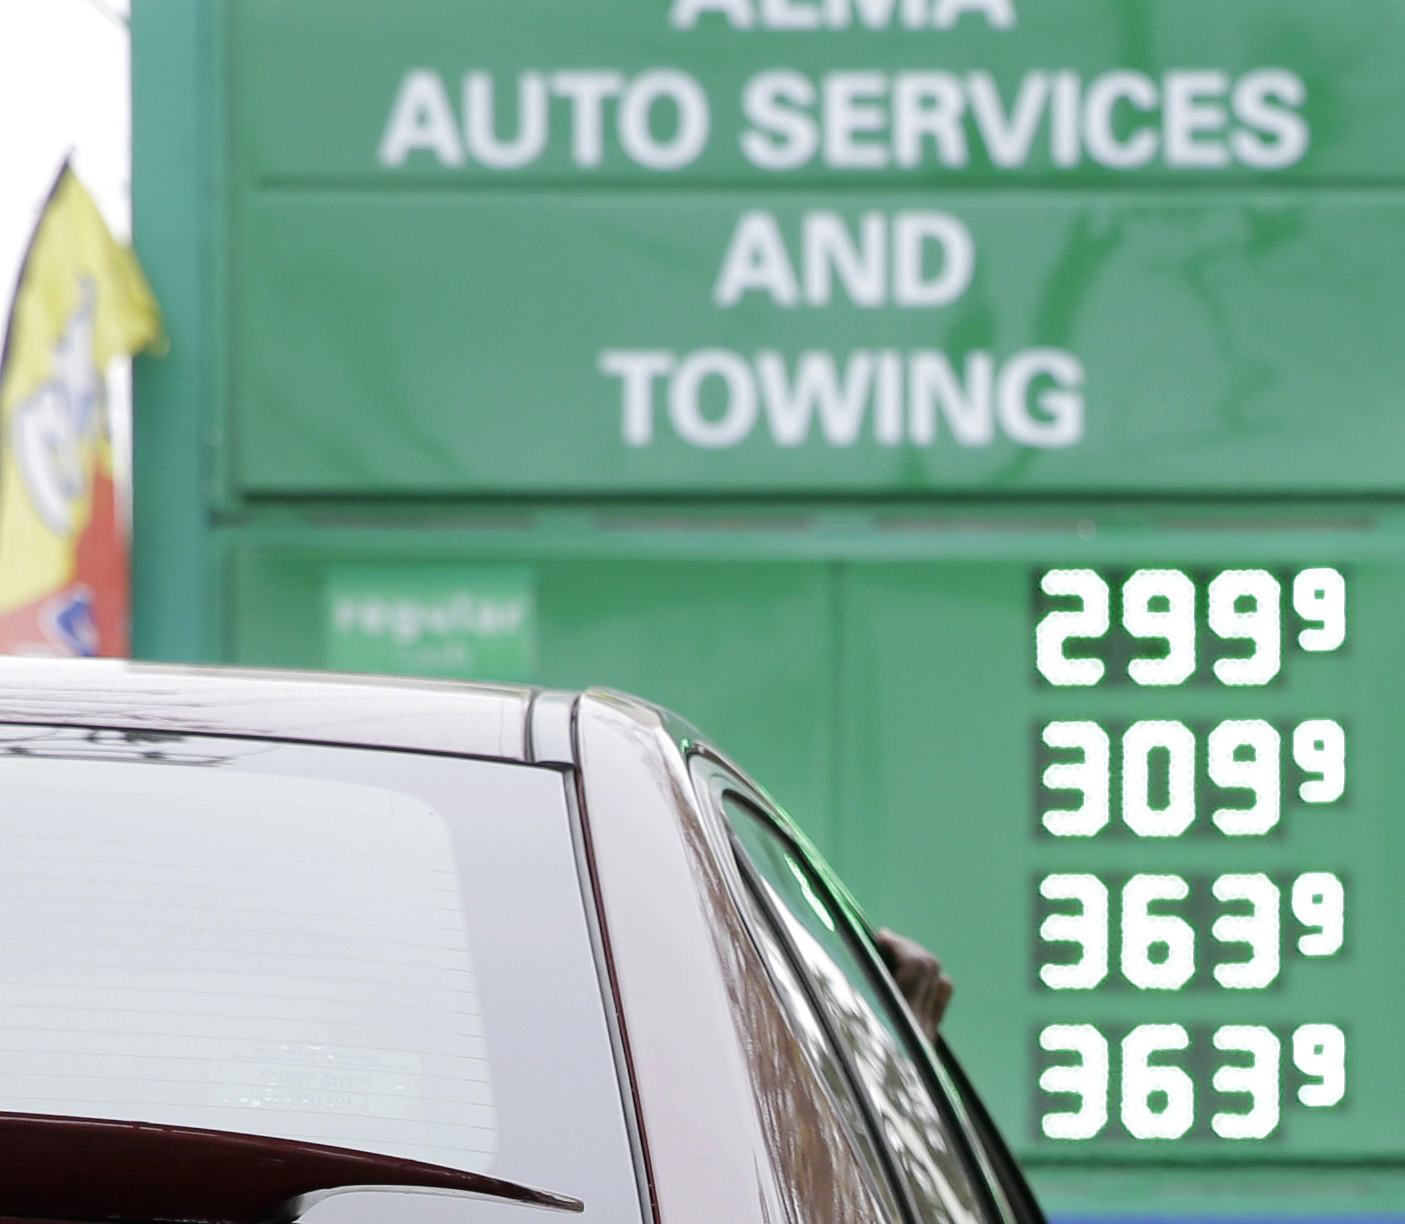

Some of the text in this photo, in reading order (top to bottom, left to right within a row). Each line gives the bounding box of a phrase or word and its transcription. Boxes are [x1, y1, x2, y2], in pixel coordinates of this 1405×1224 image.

[380, 71, 1307, 169] AUTO SERVICES
[715, 210, 975, 308] AND
[600, 350, 1085, 448] TOWING
